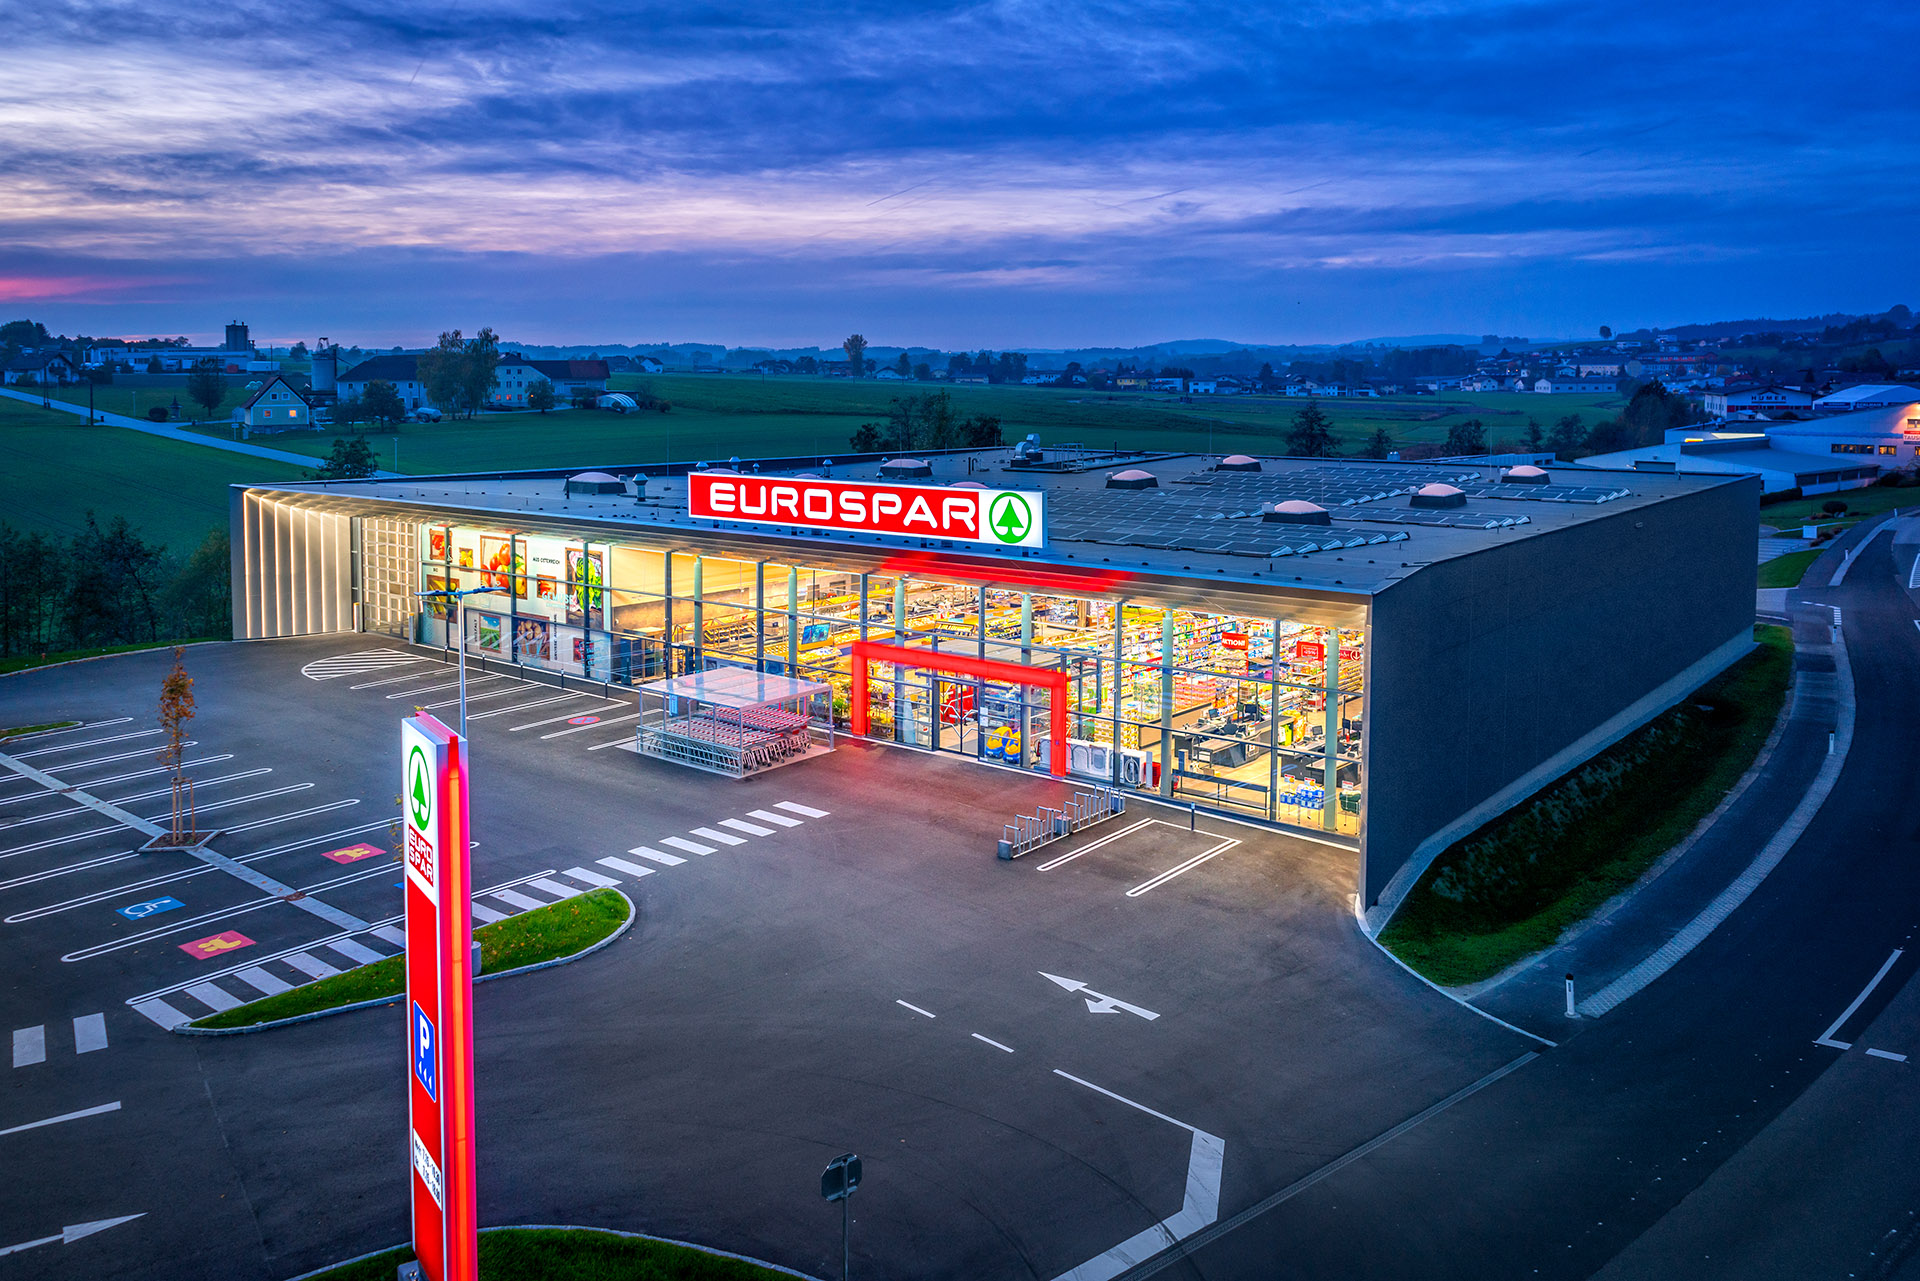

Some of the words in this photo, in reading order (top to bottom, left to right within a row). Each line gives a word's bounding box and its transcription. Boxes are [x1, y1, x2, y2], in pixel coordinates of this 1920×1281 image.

[709, 482, 976, 532] EUROSPAR
[409, 828, 433, 864] EURO
[409, 845, 433, 882] SPAR
[419, 1014, 430, 1059] P
